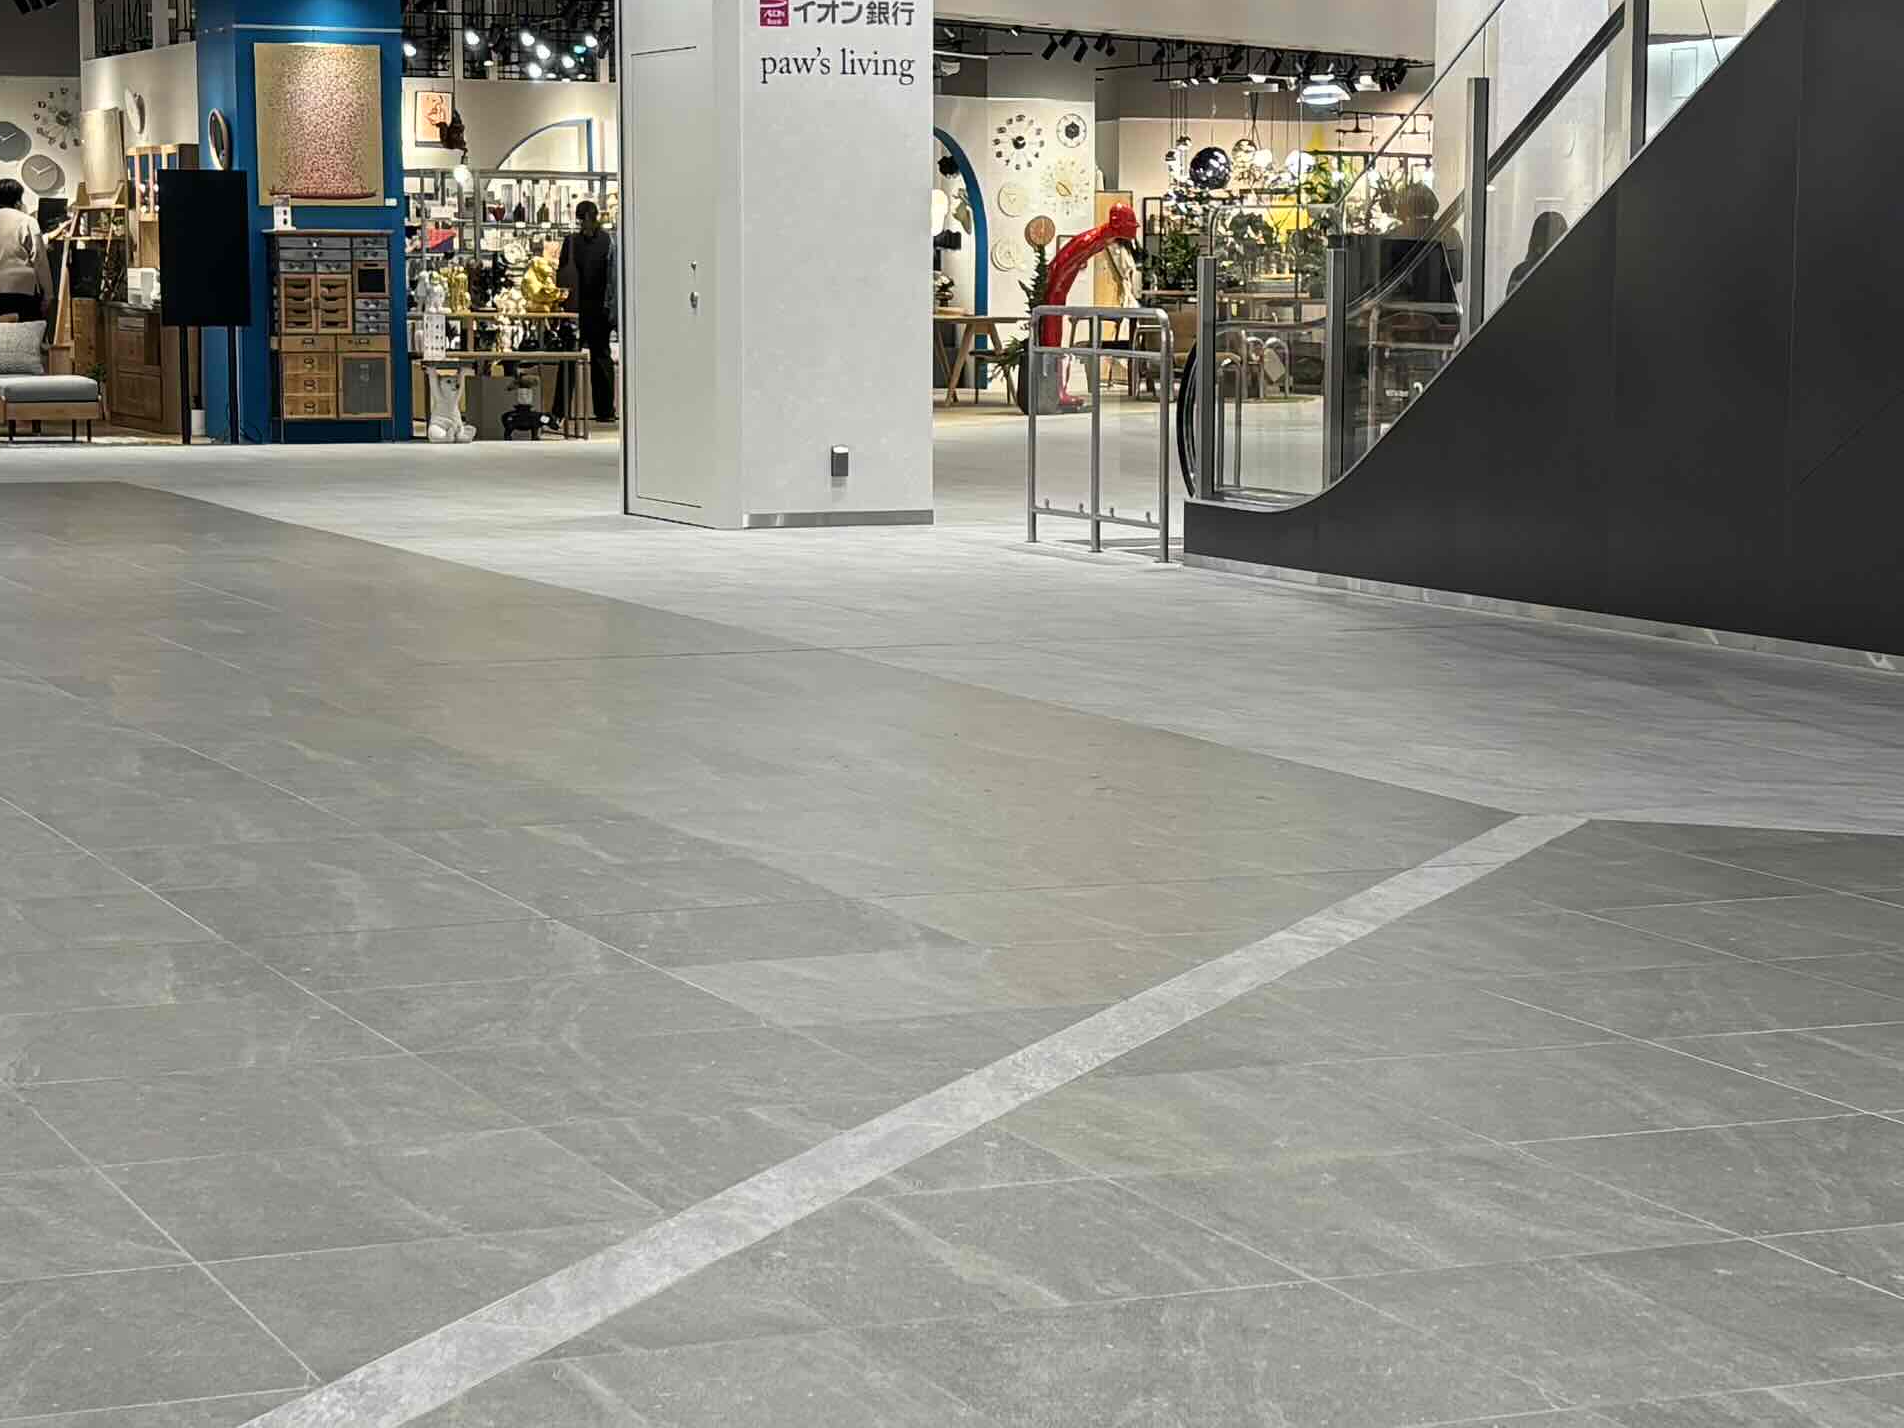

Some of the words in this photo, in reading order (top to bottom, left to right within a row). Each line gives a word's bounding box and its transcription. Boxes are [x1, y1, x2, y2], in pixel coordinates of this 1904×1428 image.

[793, 0, 915, 26] イオン銀行
[761, 47, 831, 84] paw's
[840, 48, 915, 85] living
